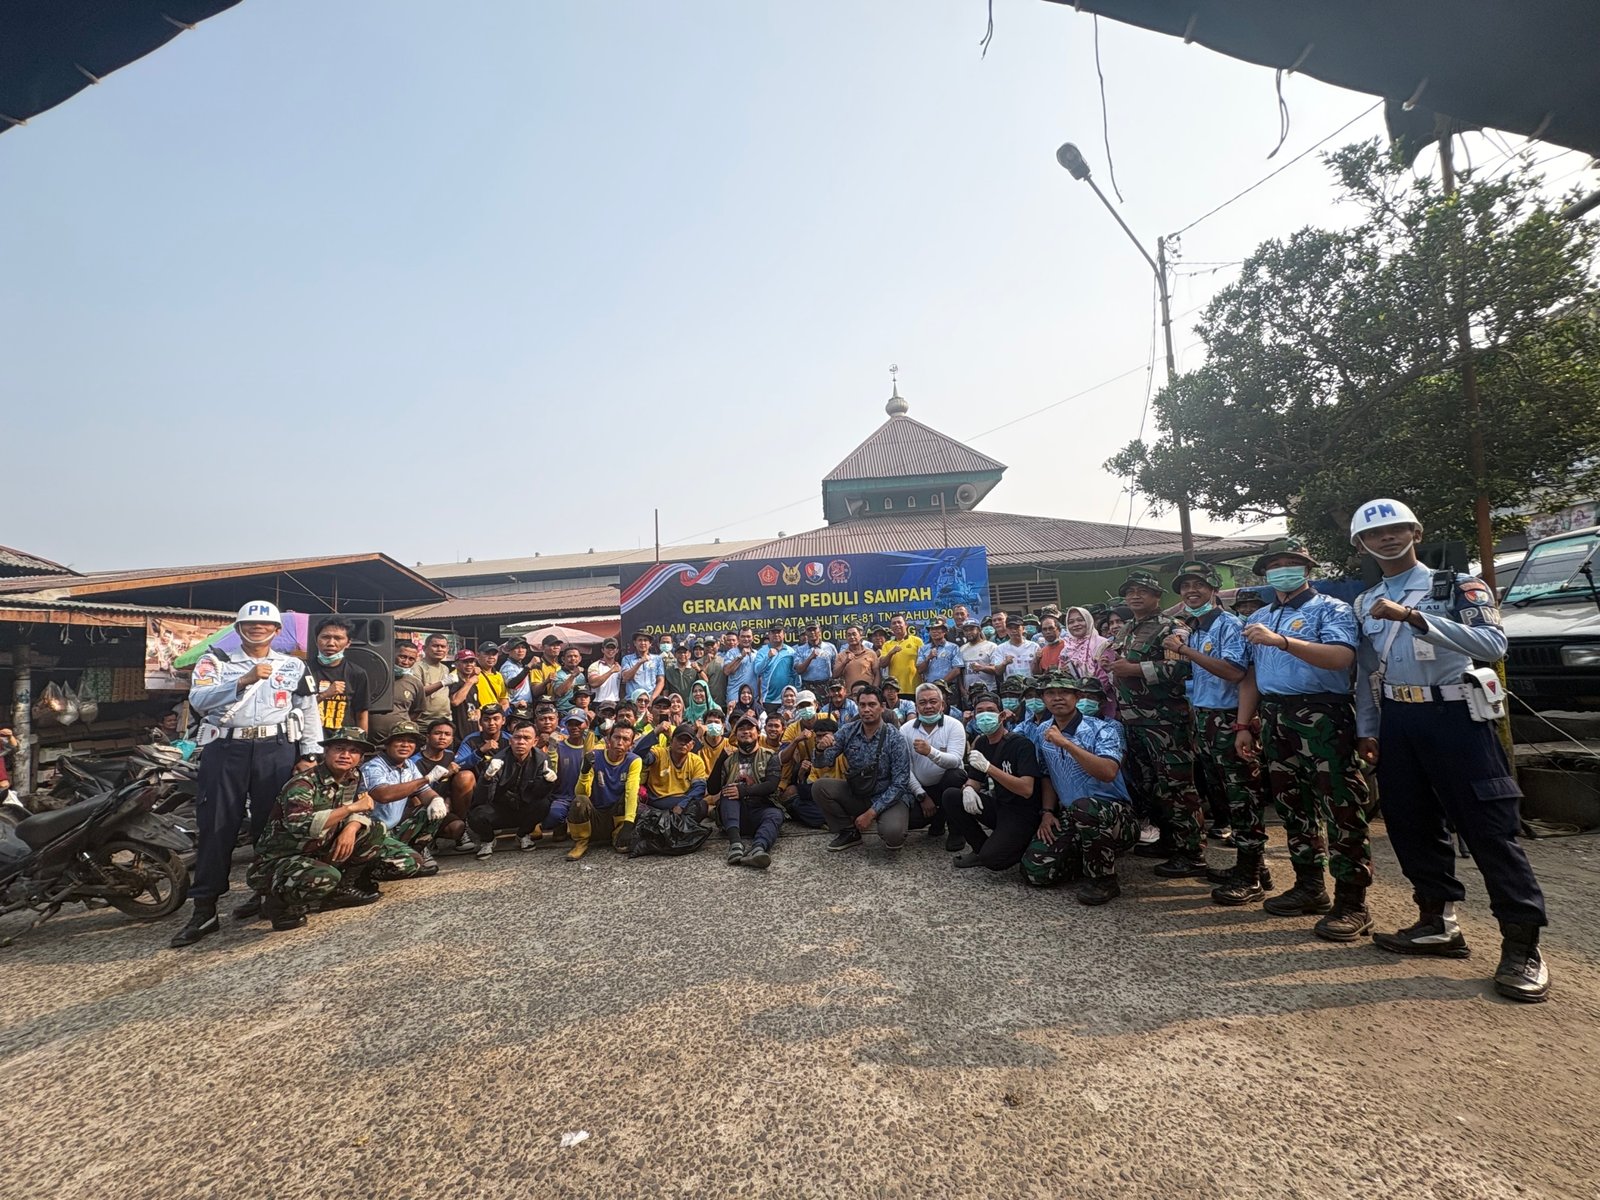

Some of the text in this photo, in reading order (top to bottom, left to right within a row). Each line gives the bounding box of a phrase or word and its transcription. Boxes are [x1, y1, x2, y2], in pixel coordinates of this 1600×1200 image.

[1363, 503, 1397, 523] PM
[248, 605, 270, 616] PM
[682, 587, 932, 614] GERAKAN TNI PEDULI SAMPAH
[646, 623, 686, 635] DALAM
[689, 620, 738, 632] RANGKA
[816, 614, 840, 625] HUT
[843, 612, 874, 624] KE-81
[878, 611, 895, 622] TN
